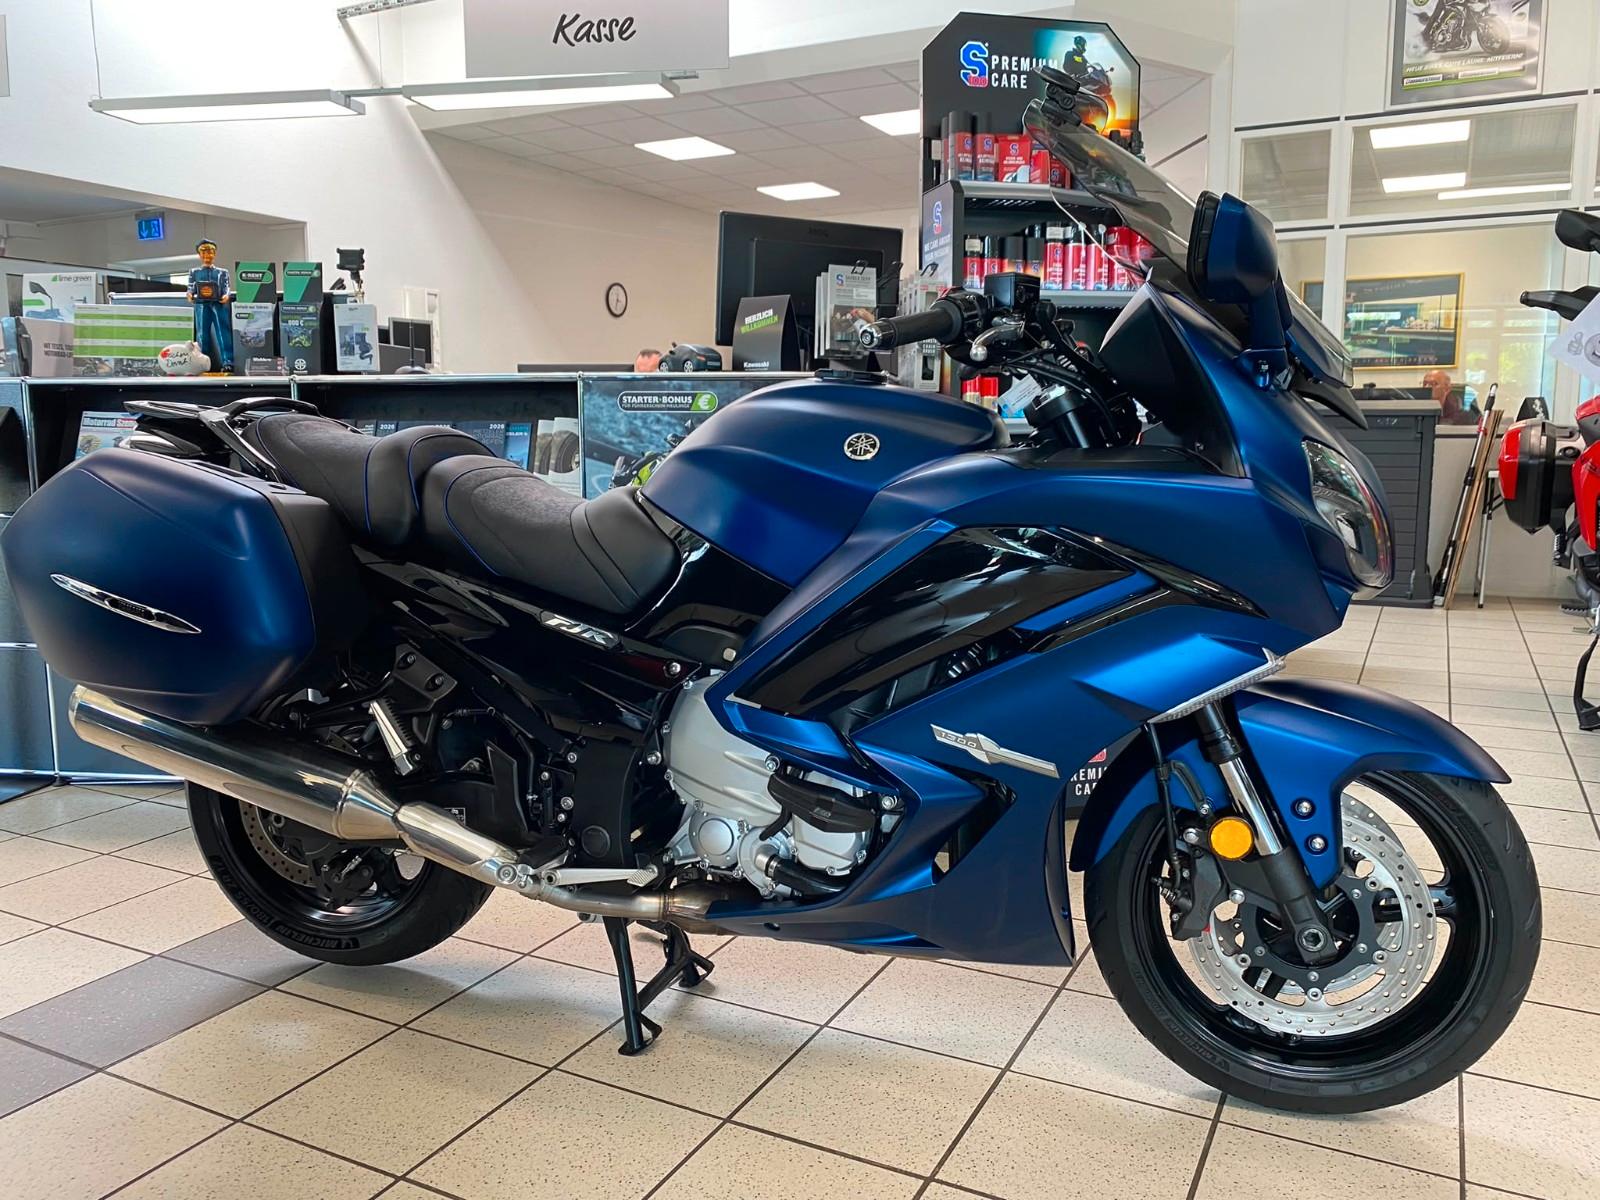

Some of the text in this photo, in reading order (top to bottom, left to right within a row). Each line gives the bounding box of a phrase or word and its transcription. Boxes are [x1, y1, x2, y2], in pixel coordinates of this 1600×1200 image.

[552, 13, 637, 47] Kasse
[991, 72, 1028, 89] CARE
[73, 275, 92, 283] green
[744, 308, 774, 325] HERZLICH
[82, 417, 116, 427] Motorrad
[545, 617, 607, 645] FJR
[940, 731, 978, 749] 1300
[275, 923, 338, 949] MICHELIN
